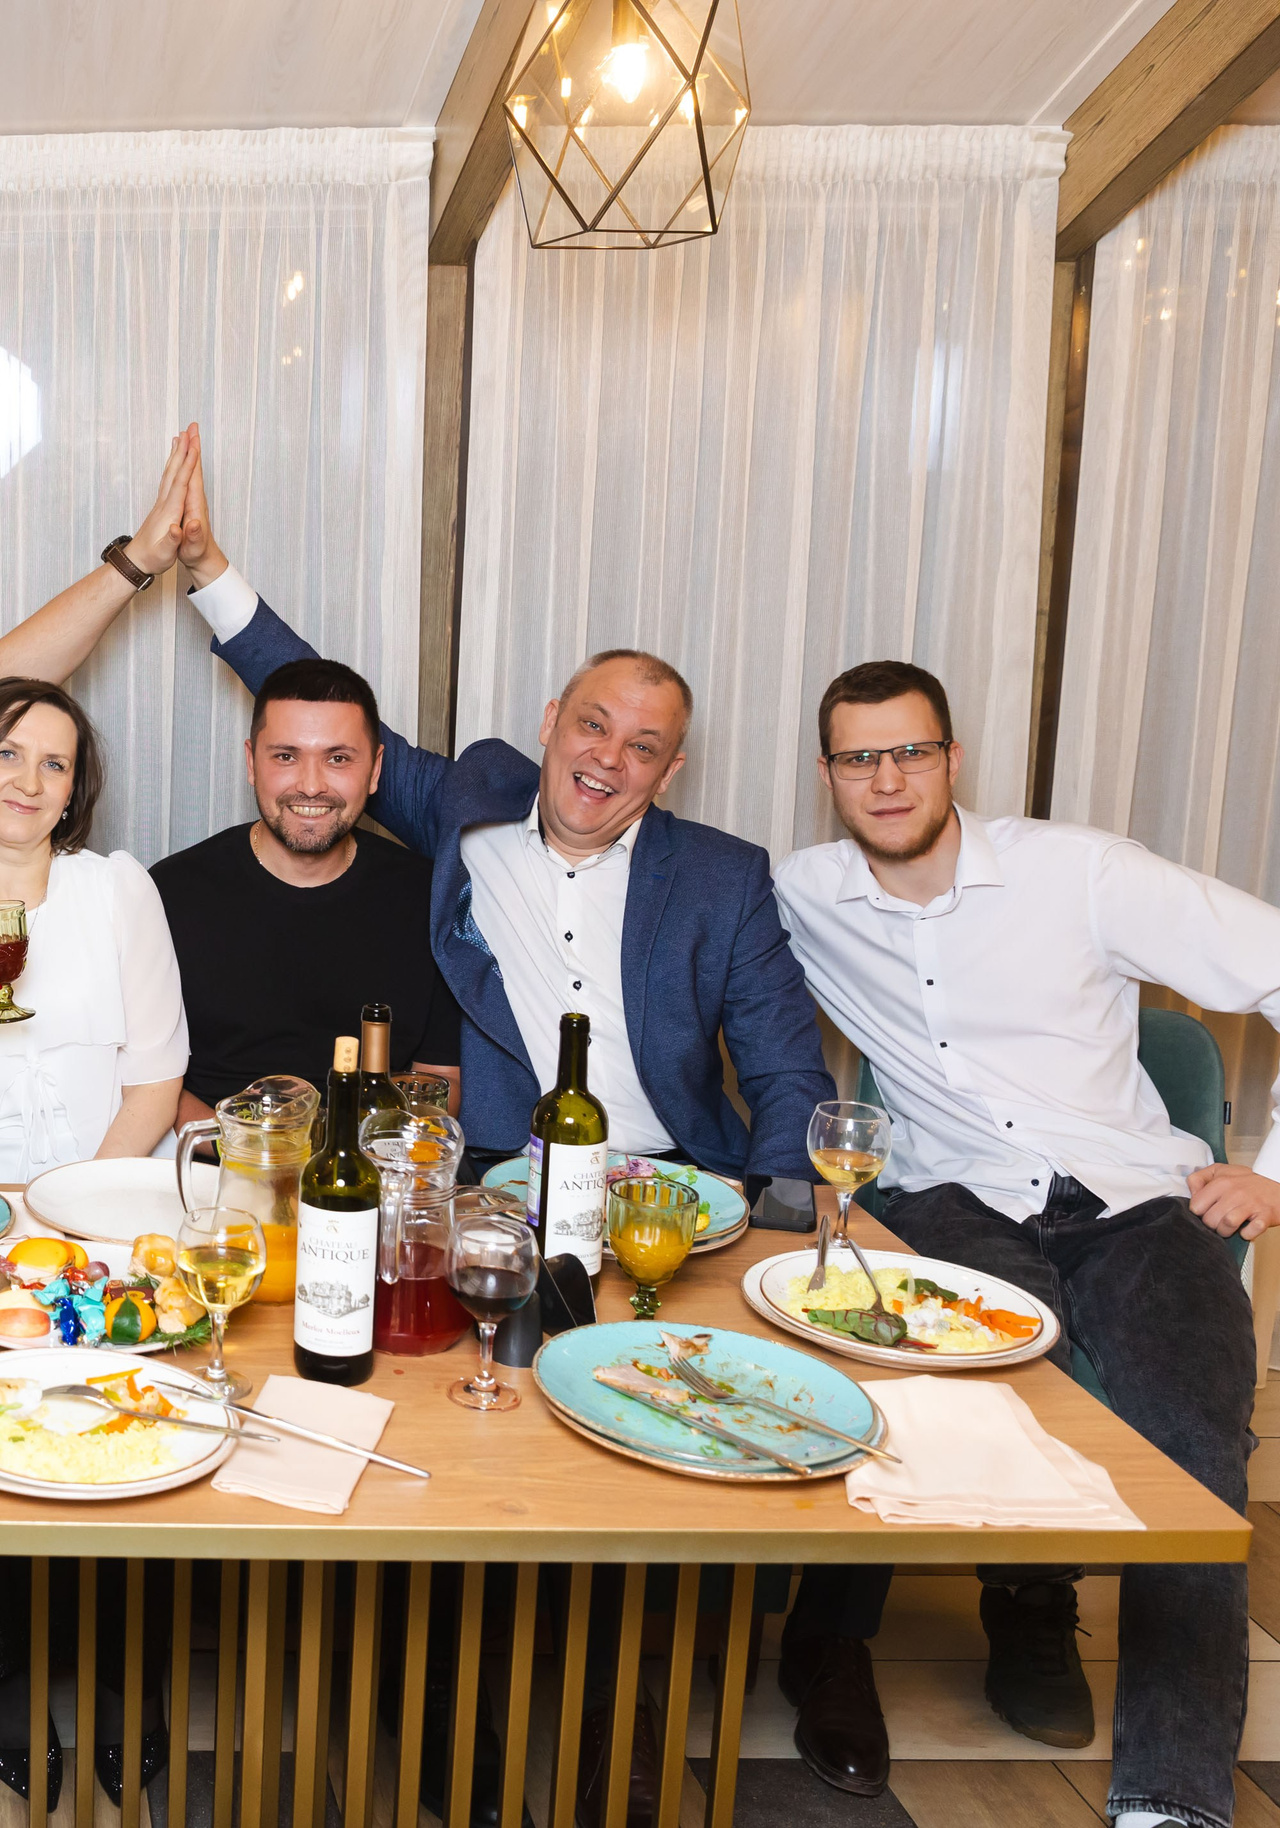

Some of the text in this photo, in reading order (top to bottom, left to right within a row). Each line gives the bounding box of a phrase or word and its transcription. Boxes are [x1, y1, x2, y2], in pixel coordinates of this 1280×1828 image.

[573, 1170, 606, 1179] CHATE
[559, 1177, 605, 1190] ANTIQ
[300, 1241, 370, 1264] ANTIQUE
